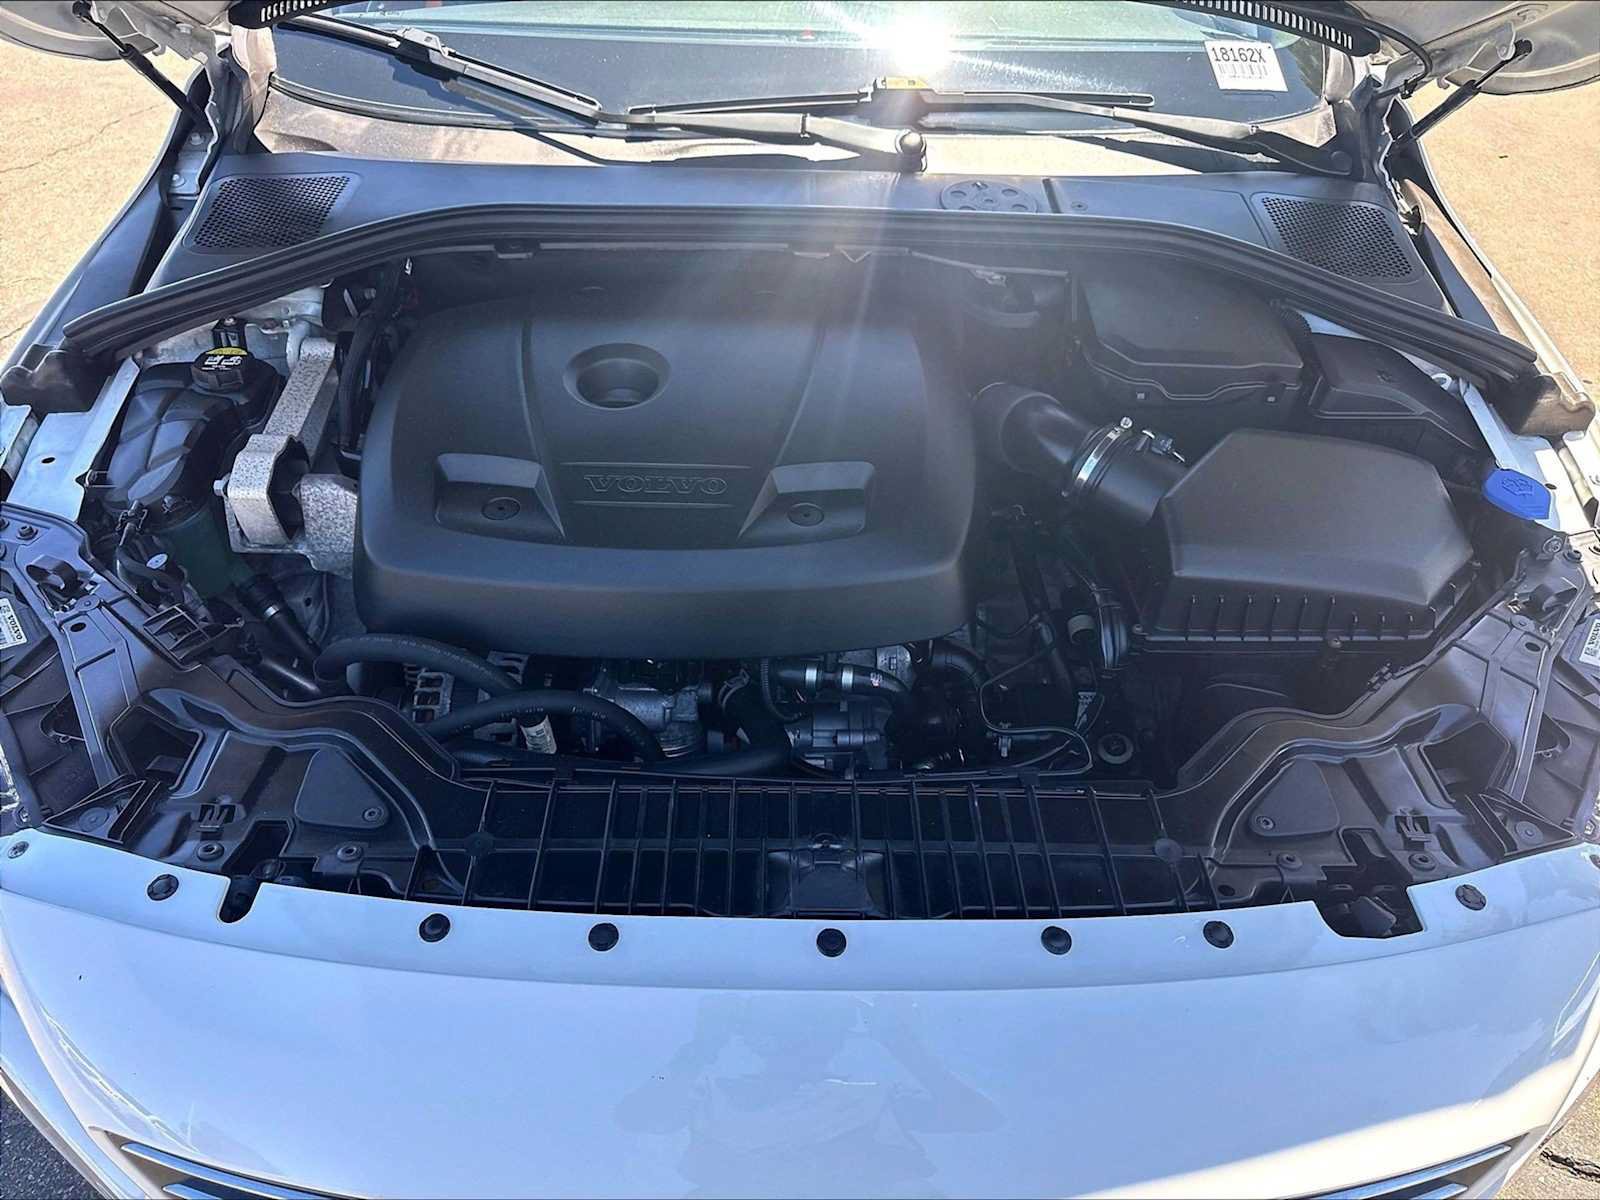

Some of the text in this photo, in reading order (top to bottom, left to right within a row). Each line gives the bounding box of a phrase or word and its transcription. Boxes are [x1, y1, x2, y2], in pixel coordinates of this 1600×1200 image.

[1211, 47, 1266, 63] 18162X
[583, 474, 728, 495] VOLVO
[8, 615, 23, 640] VOLVO
